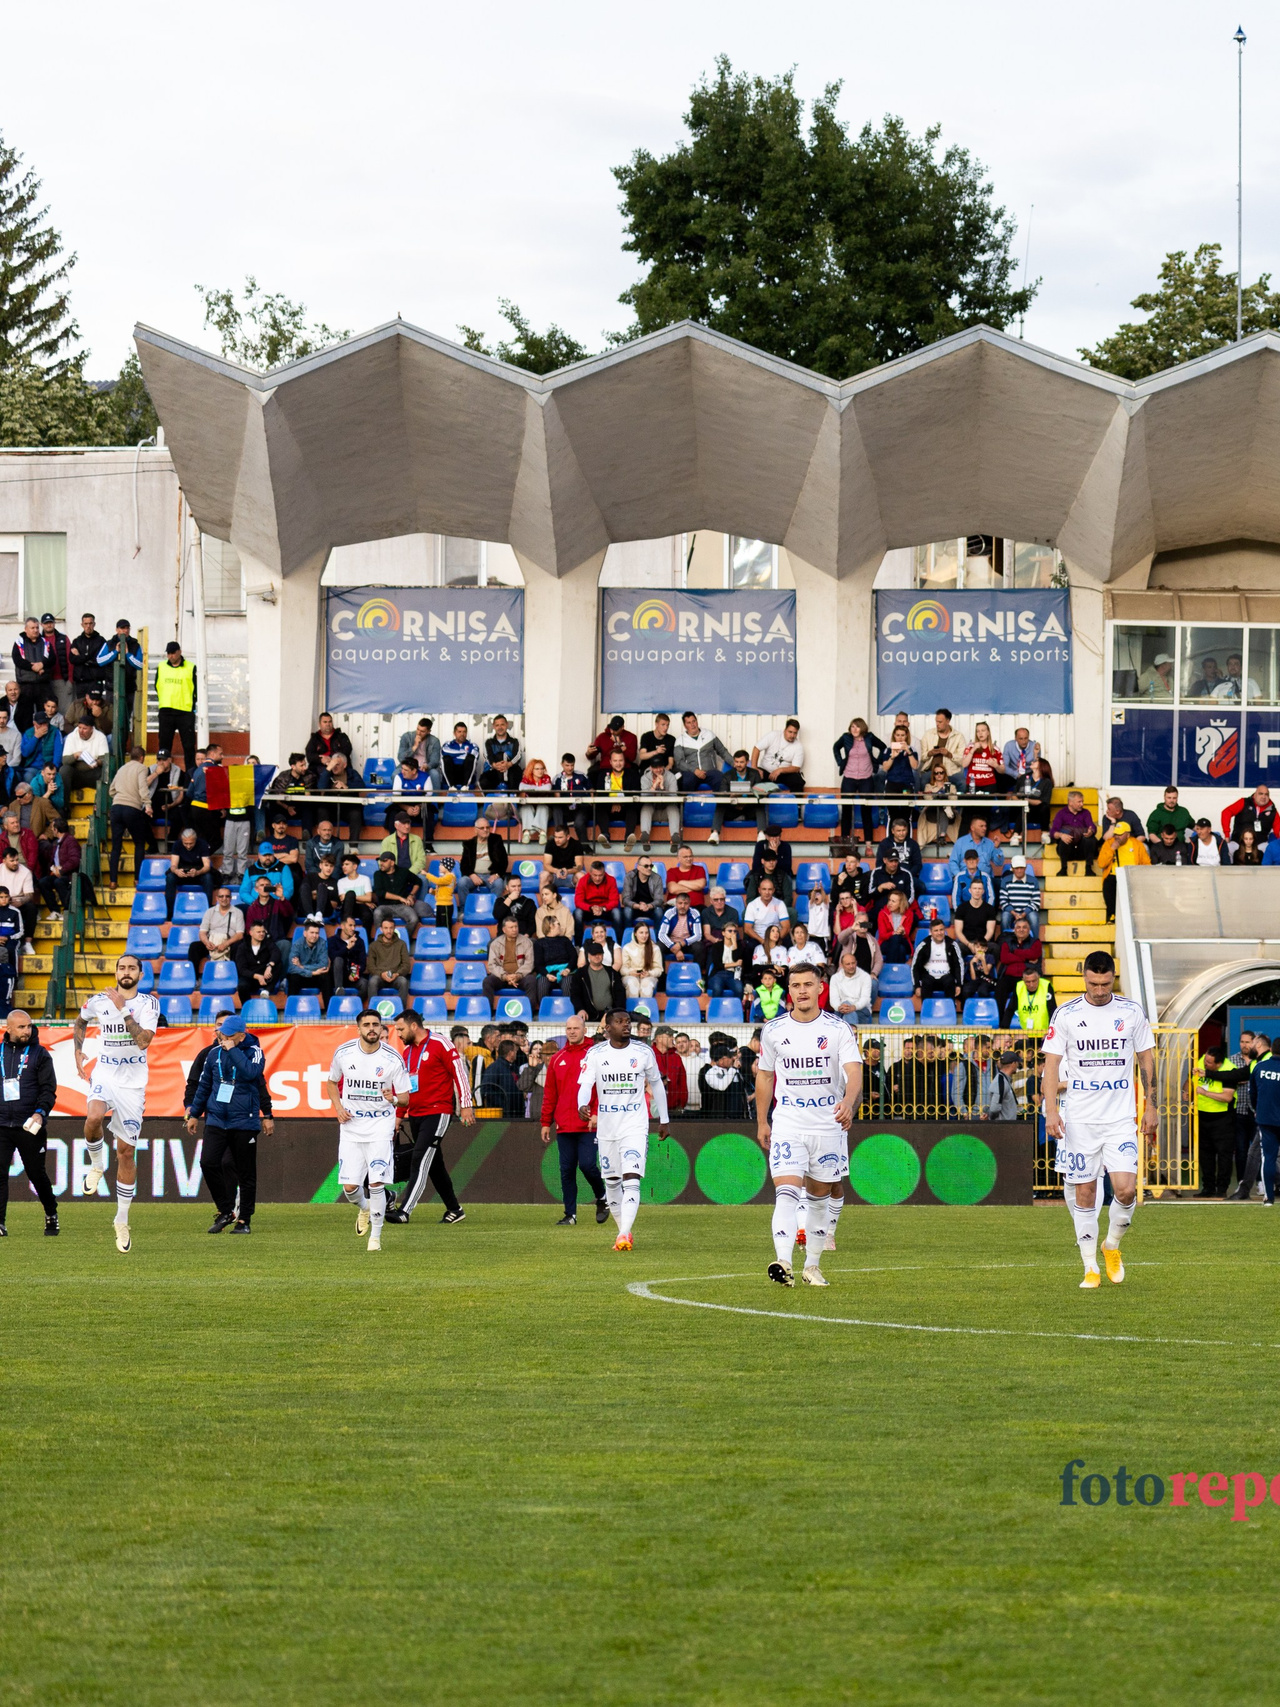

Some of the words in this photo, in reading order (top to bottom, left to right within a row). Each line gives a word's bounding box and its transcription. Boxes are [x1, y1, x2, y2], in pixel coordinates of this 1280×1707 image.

[331, 648, 429, 664] aquapark
[440, 648, 452, 661] &
[461, 648, 520, 664] sports
[607, 648, 705, 666] aquapark
[714, 648, 726, 662] &
[736, 648, 794, 666] sports
[882, 648, 980, 666] aquapark
[989, 648, 1001, 662] &
[1010, 648, 1069, 666] sports
[1071, 928, 1079, 940] 5
[1076, 1038, 1127, 1050] UNIBET
[783, 1056, 831, 1069] UNIBET
[602, 1072, 640, 1082] UNIBET
[347, 1080, 385, 1089] UNIBET
[1072, 1079, 1129, 1091] ELSACO
[600, 1103, 641, 1113] ELSACO
[781, 1095, 836, 1108] ELSACO
[773, 1141, 792, 1161] 33
[1068, 1152, 1086, 1172] 30
